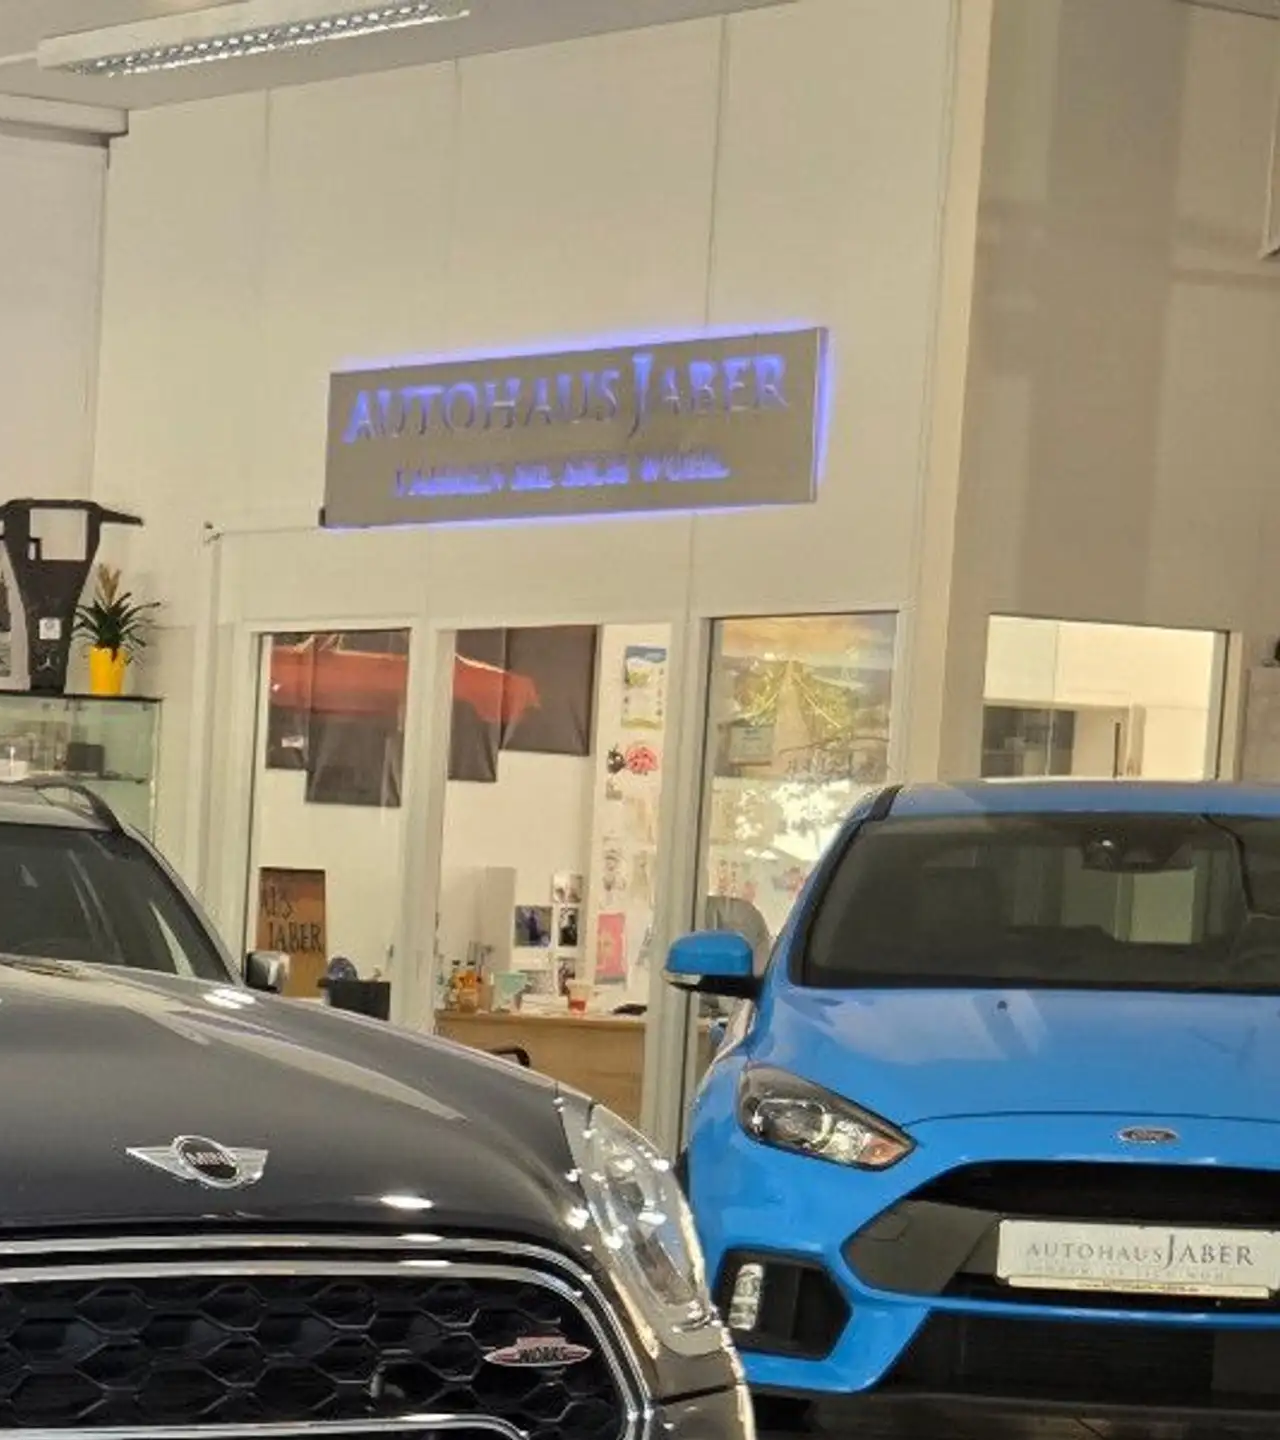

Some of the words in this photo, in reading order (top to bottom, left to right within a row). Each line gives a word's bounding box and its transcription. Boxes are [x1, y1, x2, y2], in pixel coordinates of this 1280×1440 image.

[343, 369, 620, 443] AUTOHAUS
[628, 353, 789, 438] JABER
[1026, 1242, 1162, 1263] AUTOHAUS
[1163, 1235, 1254, 1269] JABER
